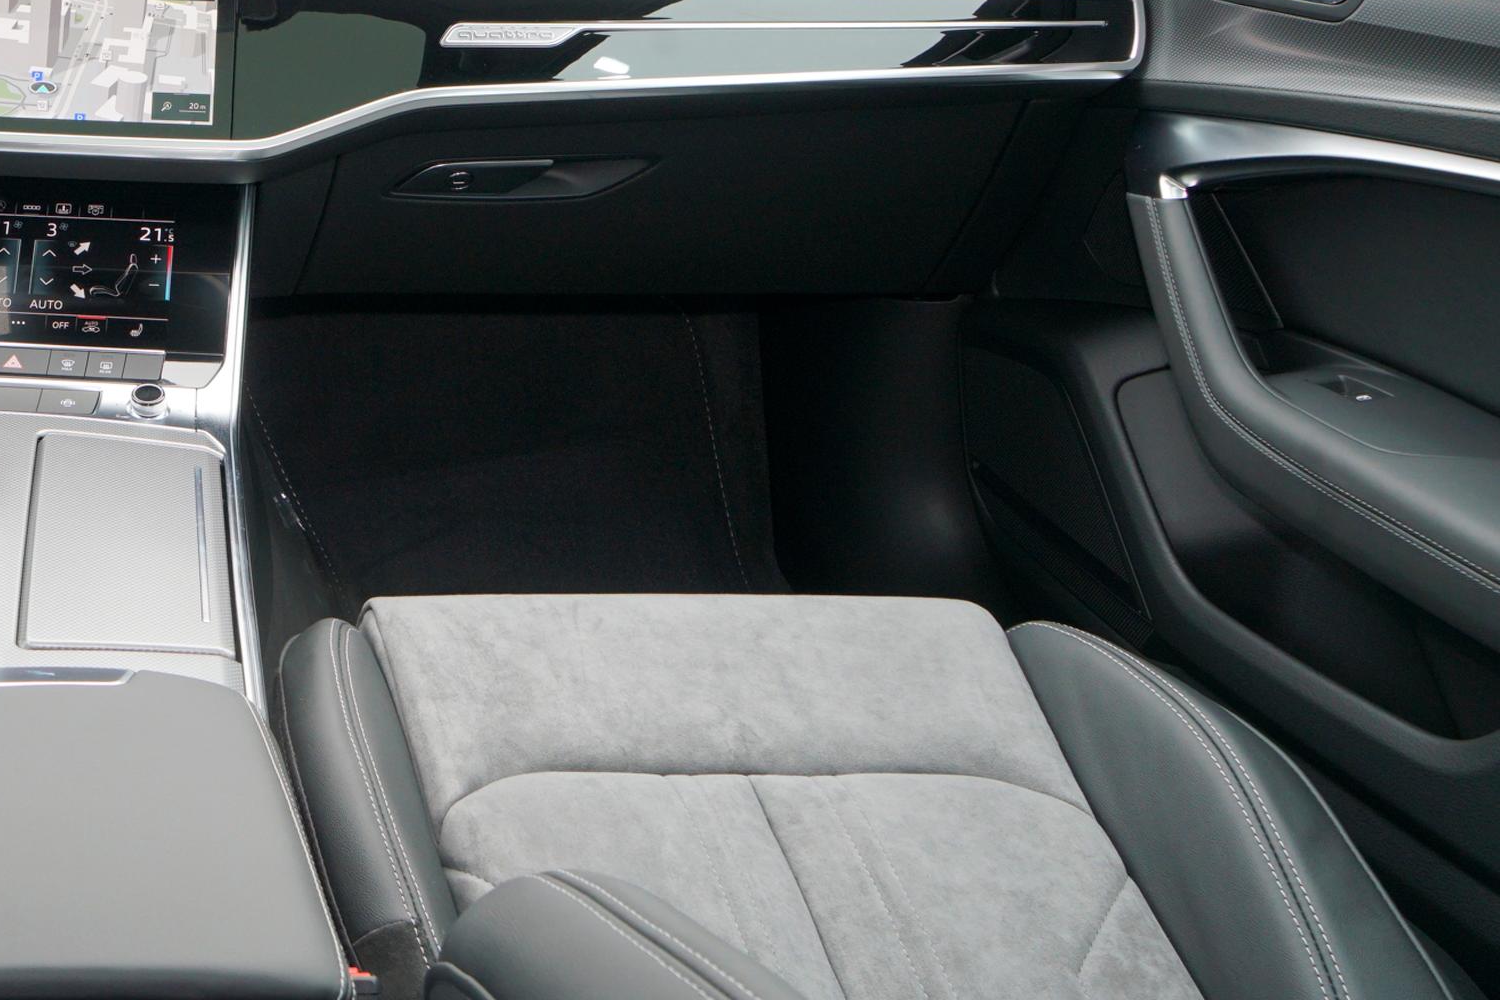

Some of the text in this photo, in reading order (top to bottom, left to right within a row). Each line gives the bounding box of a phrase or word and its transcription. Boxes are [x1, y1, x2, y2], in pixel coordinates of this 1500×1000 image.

[458, 29, 555, 41] quattro
[3, 221, 11, 235] 1
[46, 223, 57, 237] 3
[29, 300, 63, 310] AUTO
[52, 321, 70, 329] OFF
